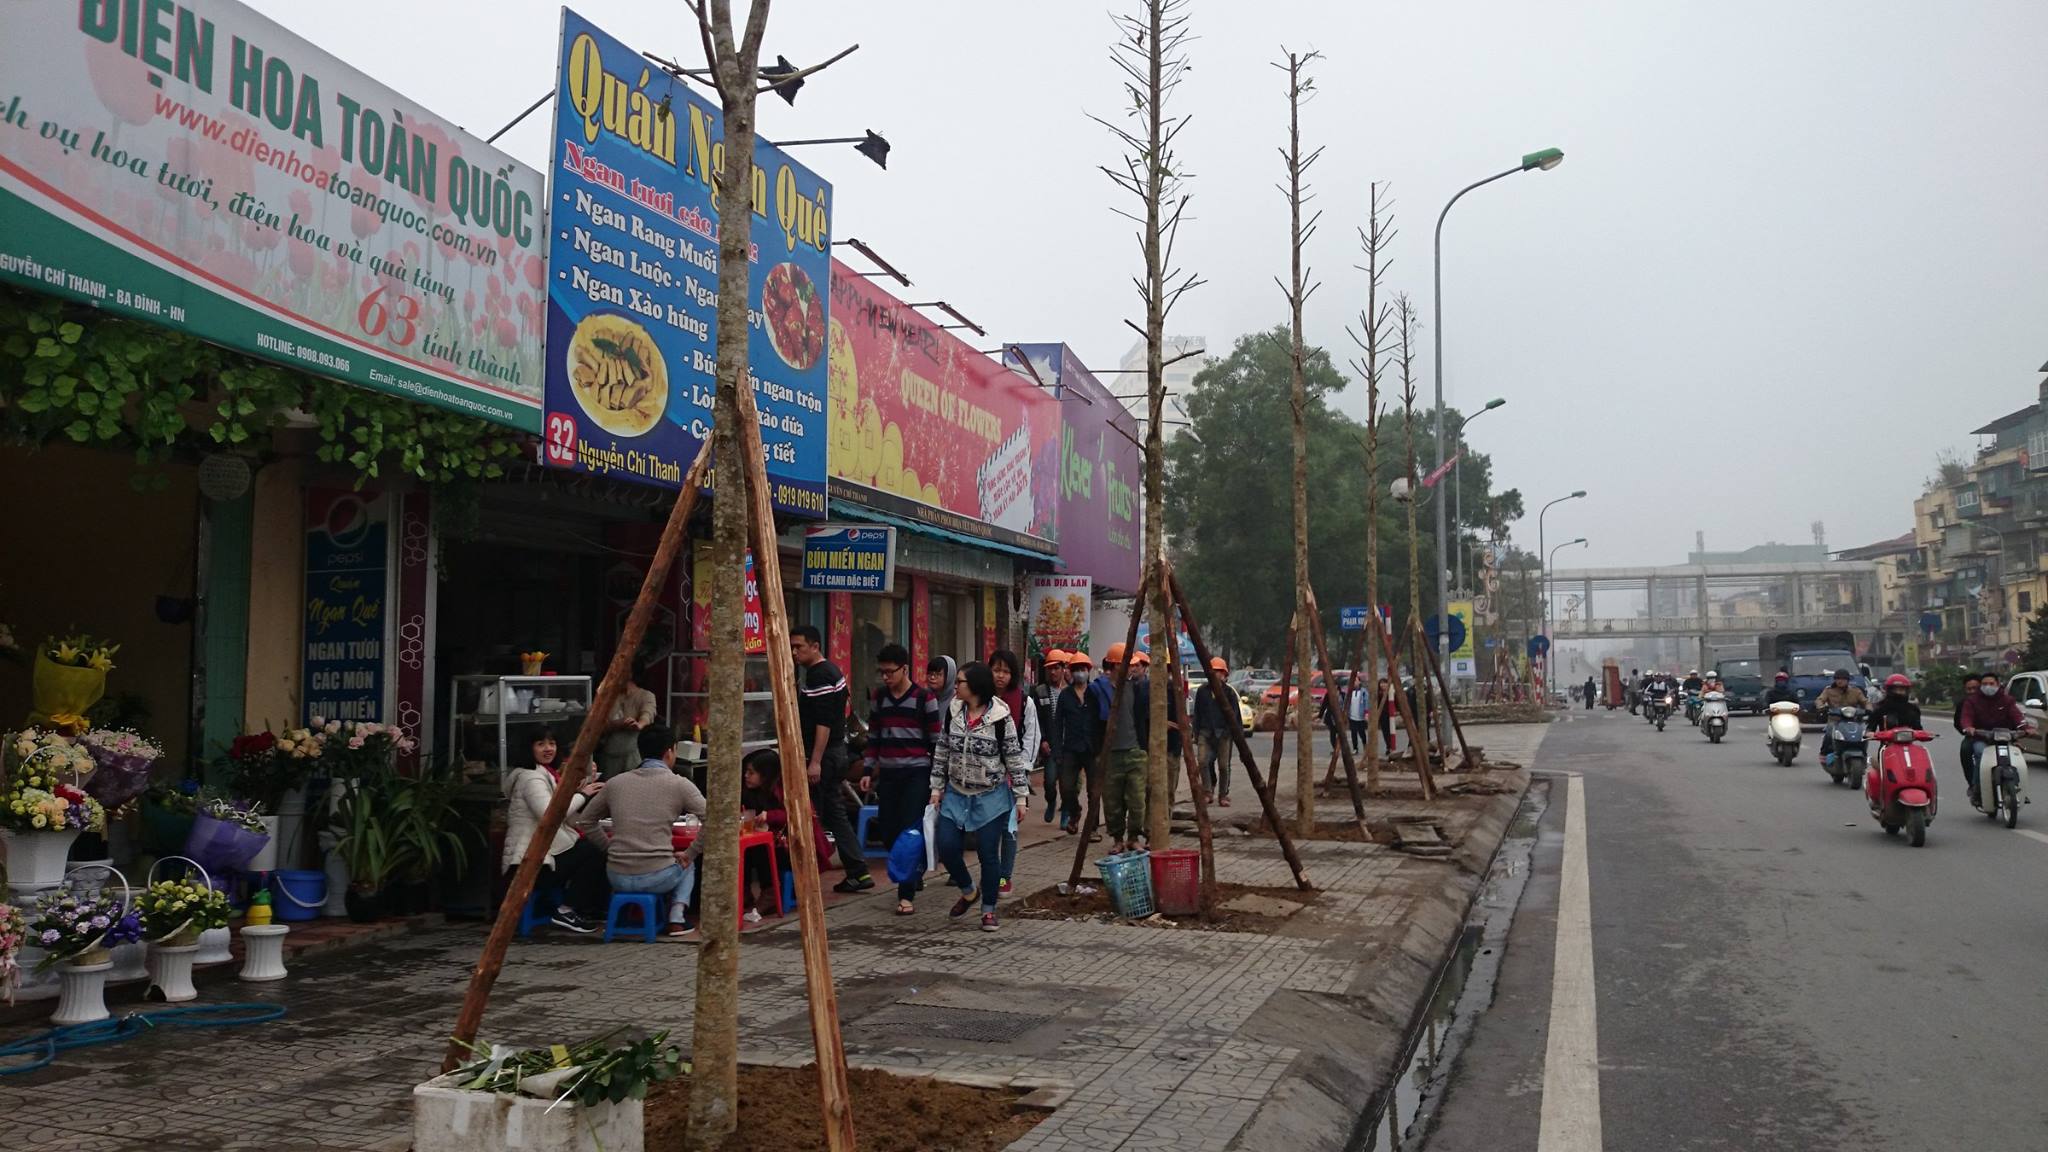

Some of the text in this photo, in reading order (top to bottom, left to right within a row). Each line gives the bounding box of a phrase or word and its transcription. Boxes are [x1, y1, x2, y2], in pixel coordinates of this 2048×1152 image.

[230, 34, 324, 149] HOA
[337, 92, 438, 204] TOÀN
[448, 164, 533, 249] QUỐC
[569, 33, 828, 251] Quán Ngn Quê
[153, 90, 499, 267] www.dienhoatoanquoc.com.vn
[564, 140, 712, 233] Ngan tươi các
[39, 121, 456, 304] vụ hoa tươi, điện hoa và quà tặng
[575, 188, 626, 232] Ngan
[631, 214, 676, 257] Rang
[680, 241, 717, 275] Muối
[574, 226, 626, 270] Ngan
[630, 254, 672, 289] Luộc
[45, 267, 65, 287] CHÍ
[68, 274, 106, 299] THANH
[117, 289, 131, 307] BA
[135, 293, 160, 315] ĐÌNH
[170, 305, 185, 323] HN
[572, 265, 709, 342] Ngan Xào húng
[257, 332, 296, 357] HOTLINE:
[358, 285, 419, 347] 63
[468, 348, 522, 386] thành
[369, 368, 396, 386] Email:
[763, 379, 794, 402] ngan
[797, 390, 823, 413] trộn
[901, 367, 939, 416] QUEEN
[957, 397, 1001, 444] FLOWERS
[549, 416, 574, 461] 32
[577, 438, 625, 474] Nguyễn
[626, 449, 647, 476] Chí
[648, 456, 681, 483] Thanh
[778, 484, 796, 505] 0919
[773, 442, 796, 463] tiết
[327, 551, 364, 566] pepsi
[807, 546, 885, 571] BÚN MIẾN NGAN
[861, 531, 885, 542] pepsi
[810, 571, 826, 586] TIẾT
[826, 574, 846, 587] CANH
[863, 574, 880, 589] BIỆT
[1070, 578, 1088, 588] LAN
[308, 637, 380, 661] NGAN TƯƠI
[312, 667, 374, 690] CÁC MÓN
[339, 696, 376, 719] MIẾN
